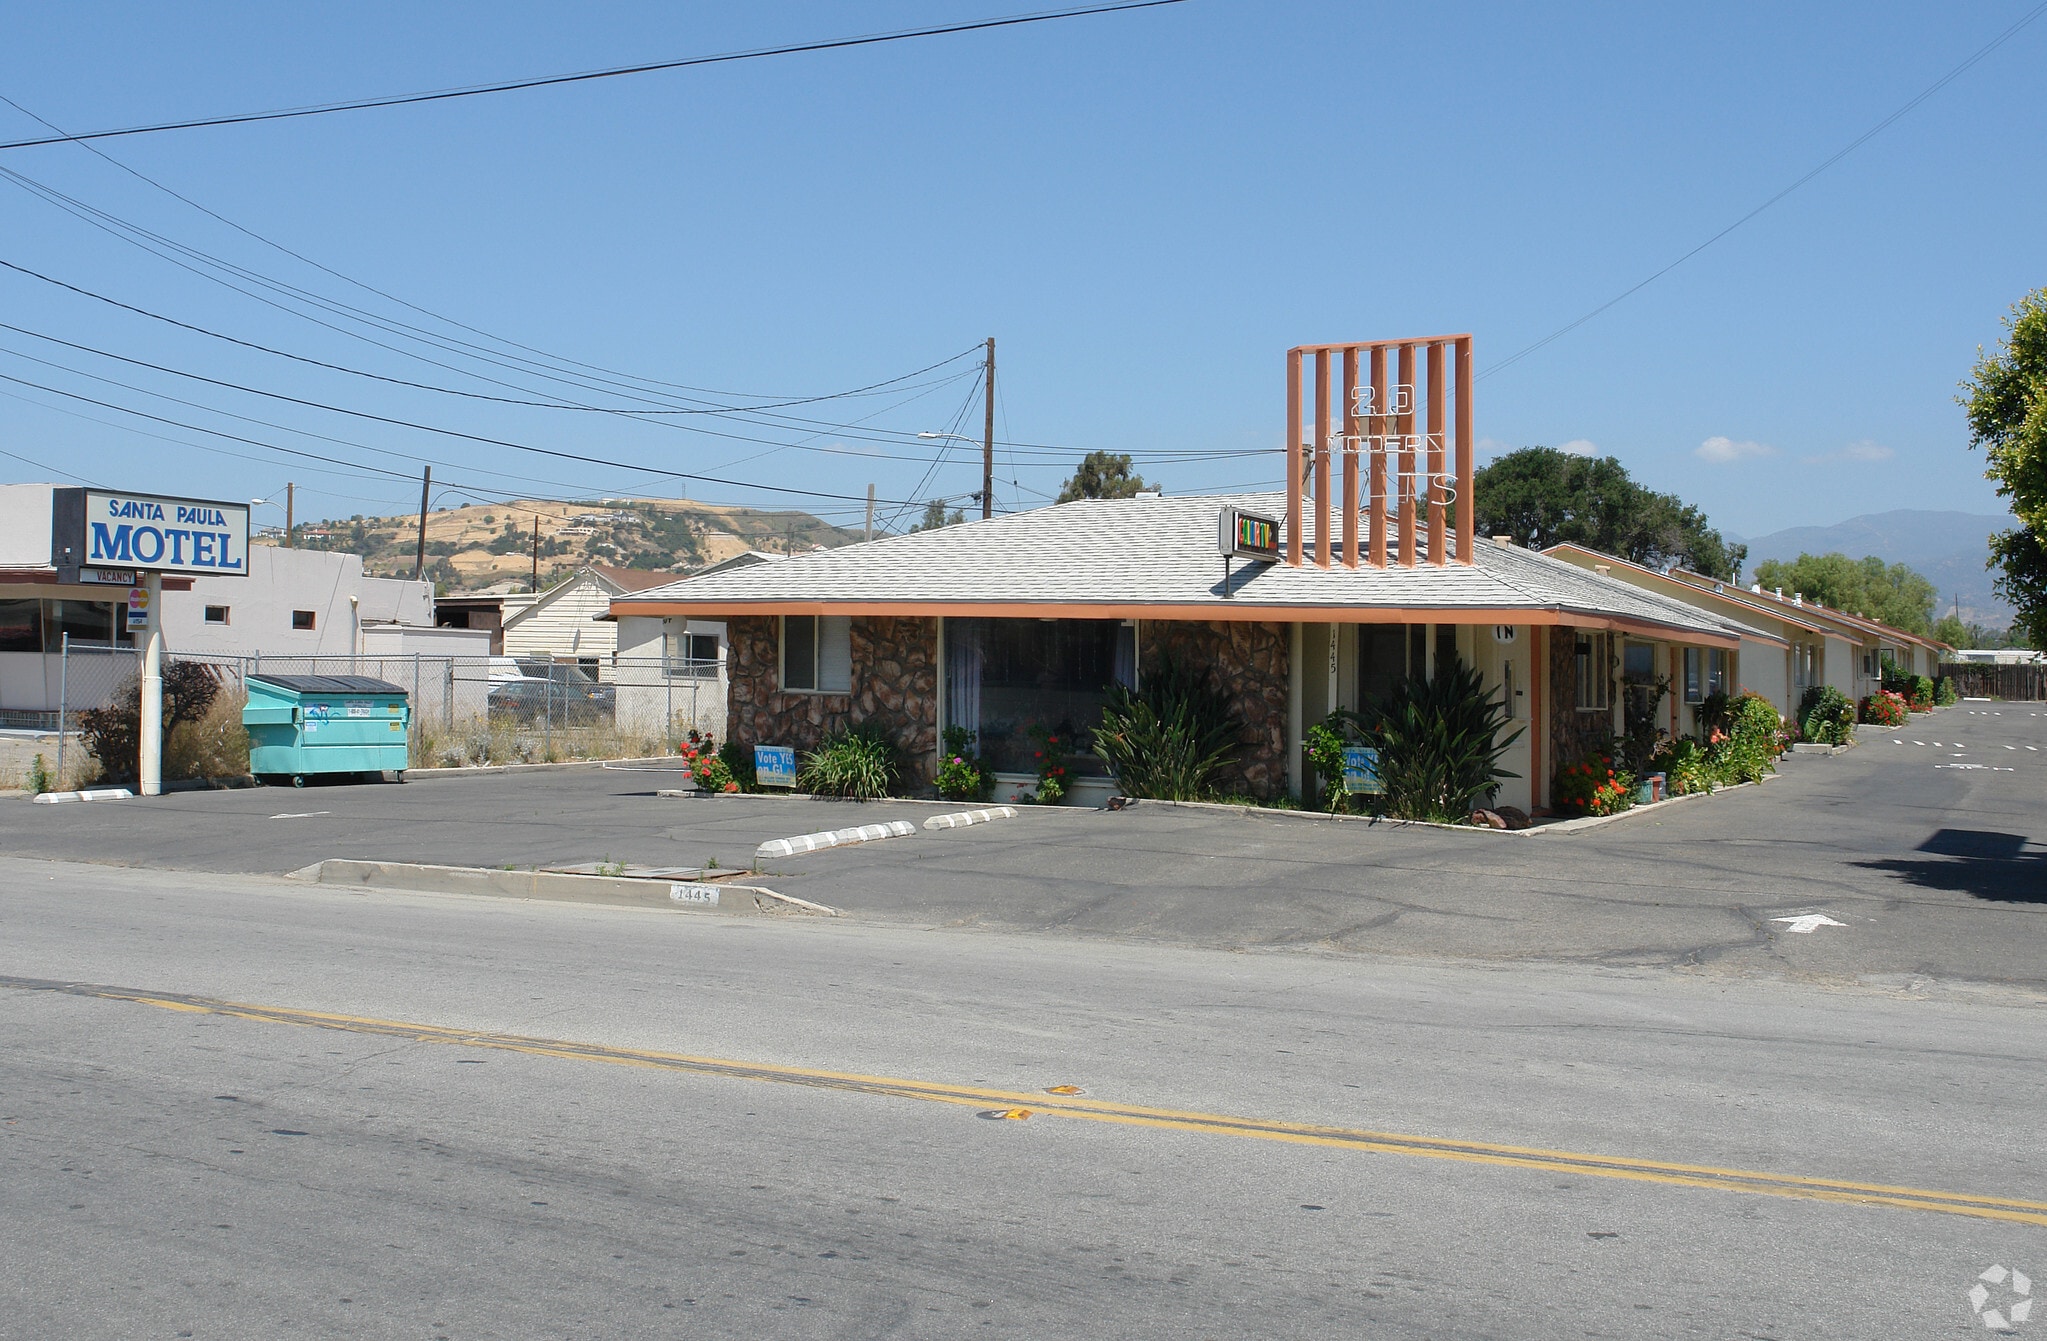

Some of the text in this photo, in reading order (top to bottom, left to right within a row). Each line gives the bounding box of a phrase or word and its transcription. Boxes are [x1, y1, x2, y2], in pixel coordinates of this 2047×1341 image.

[109, 499, 227, 526] SANTA PAULA
[91, 522, 242, 569] MOTEL
[97, 571, 133, 583] VACANCY
[1496, 625, 1513, 639] IN
[757, 751, 793, 765] Vote YES
[678, 889, 711, 902] 1445
